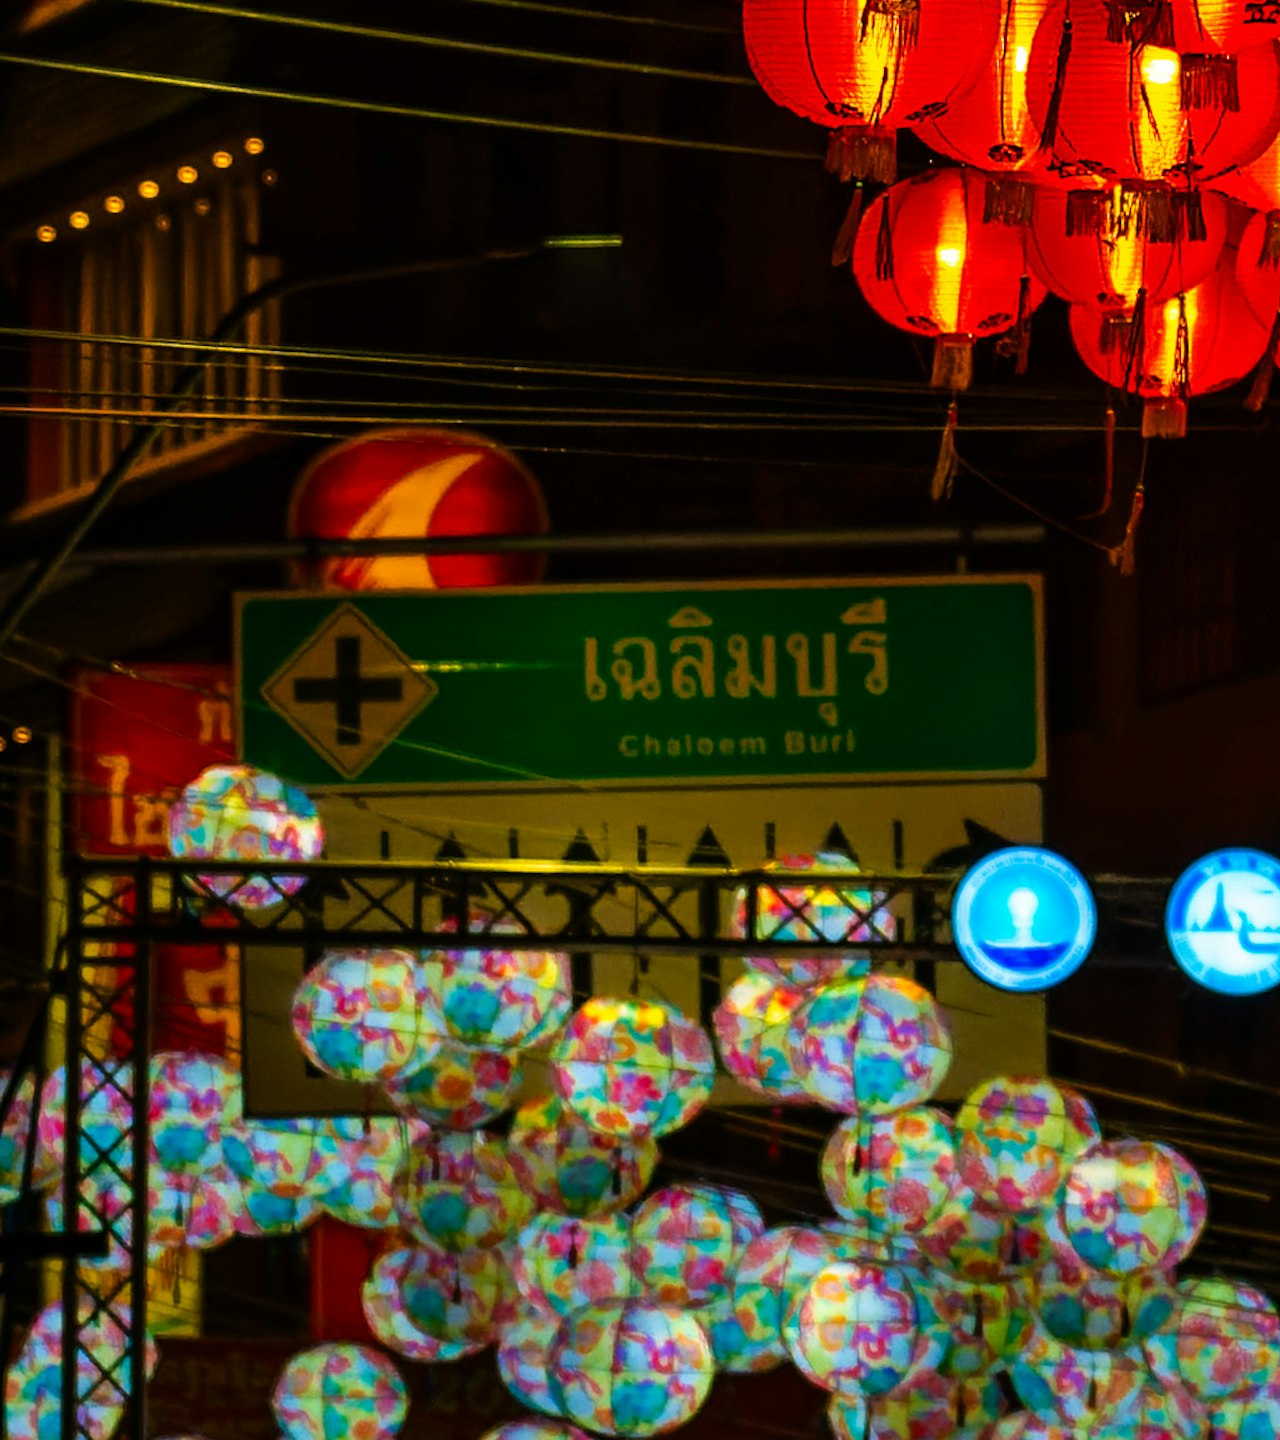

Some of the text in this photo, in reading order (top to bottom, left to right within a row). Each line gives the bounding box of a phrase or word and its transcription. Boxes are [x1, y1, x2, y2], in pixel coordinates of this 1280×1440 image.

[583, 596, 889, 728] เฉลิมบุรี
[617, 728, 857, 758] Chaloem Buri
